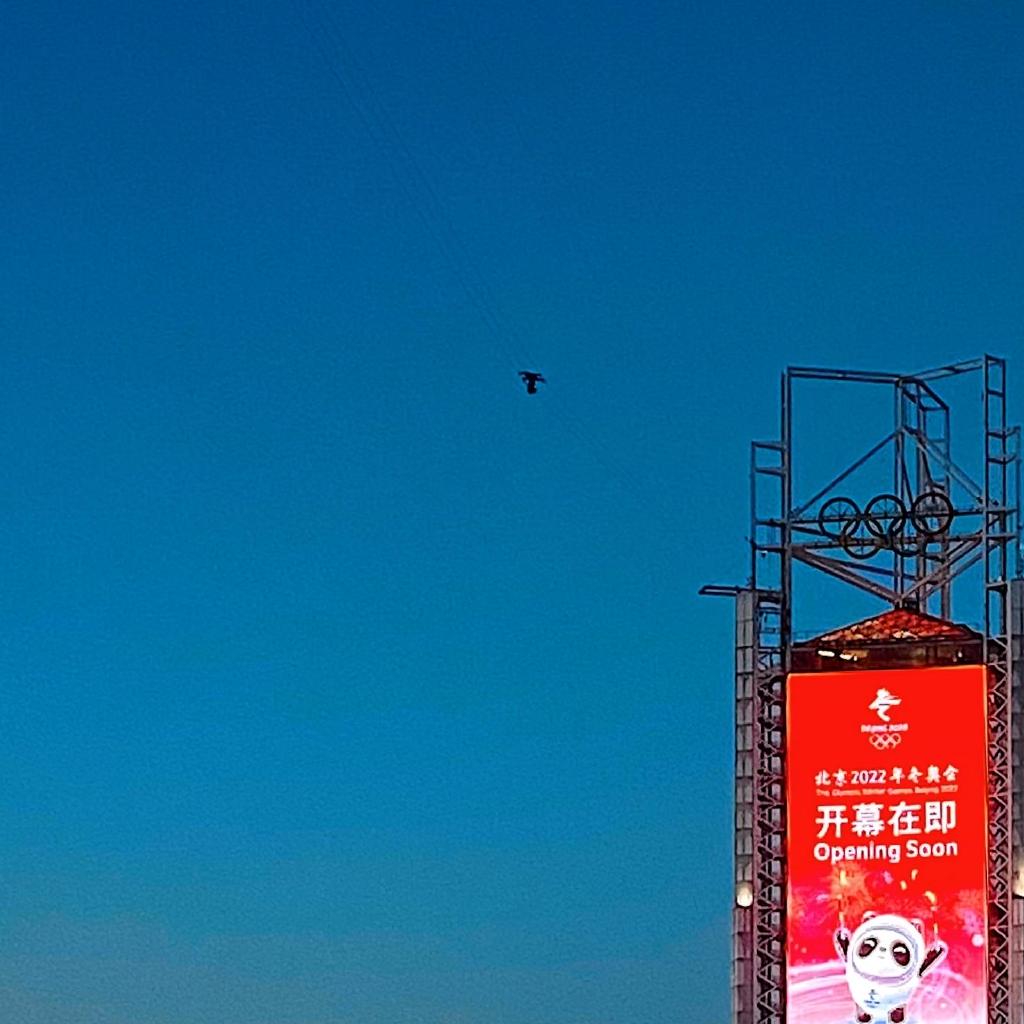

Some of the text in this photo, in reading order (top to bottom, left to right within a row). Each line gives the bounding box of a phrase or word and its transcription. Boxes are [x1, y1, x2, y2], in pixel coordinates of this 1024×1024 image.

[815, 801, 956, 838] 开幕在即
[814, 840, 957, 864] Opening Soon
